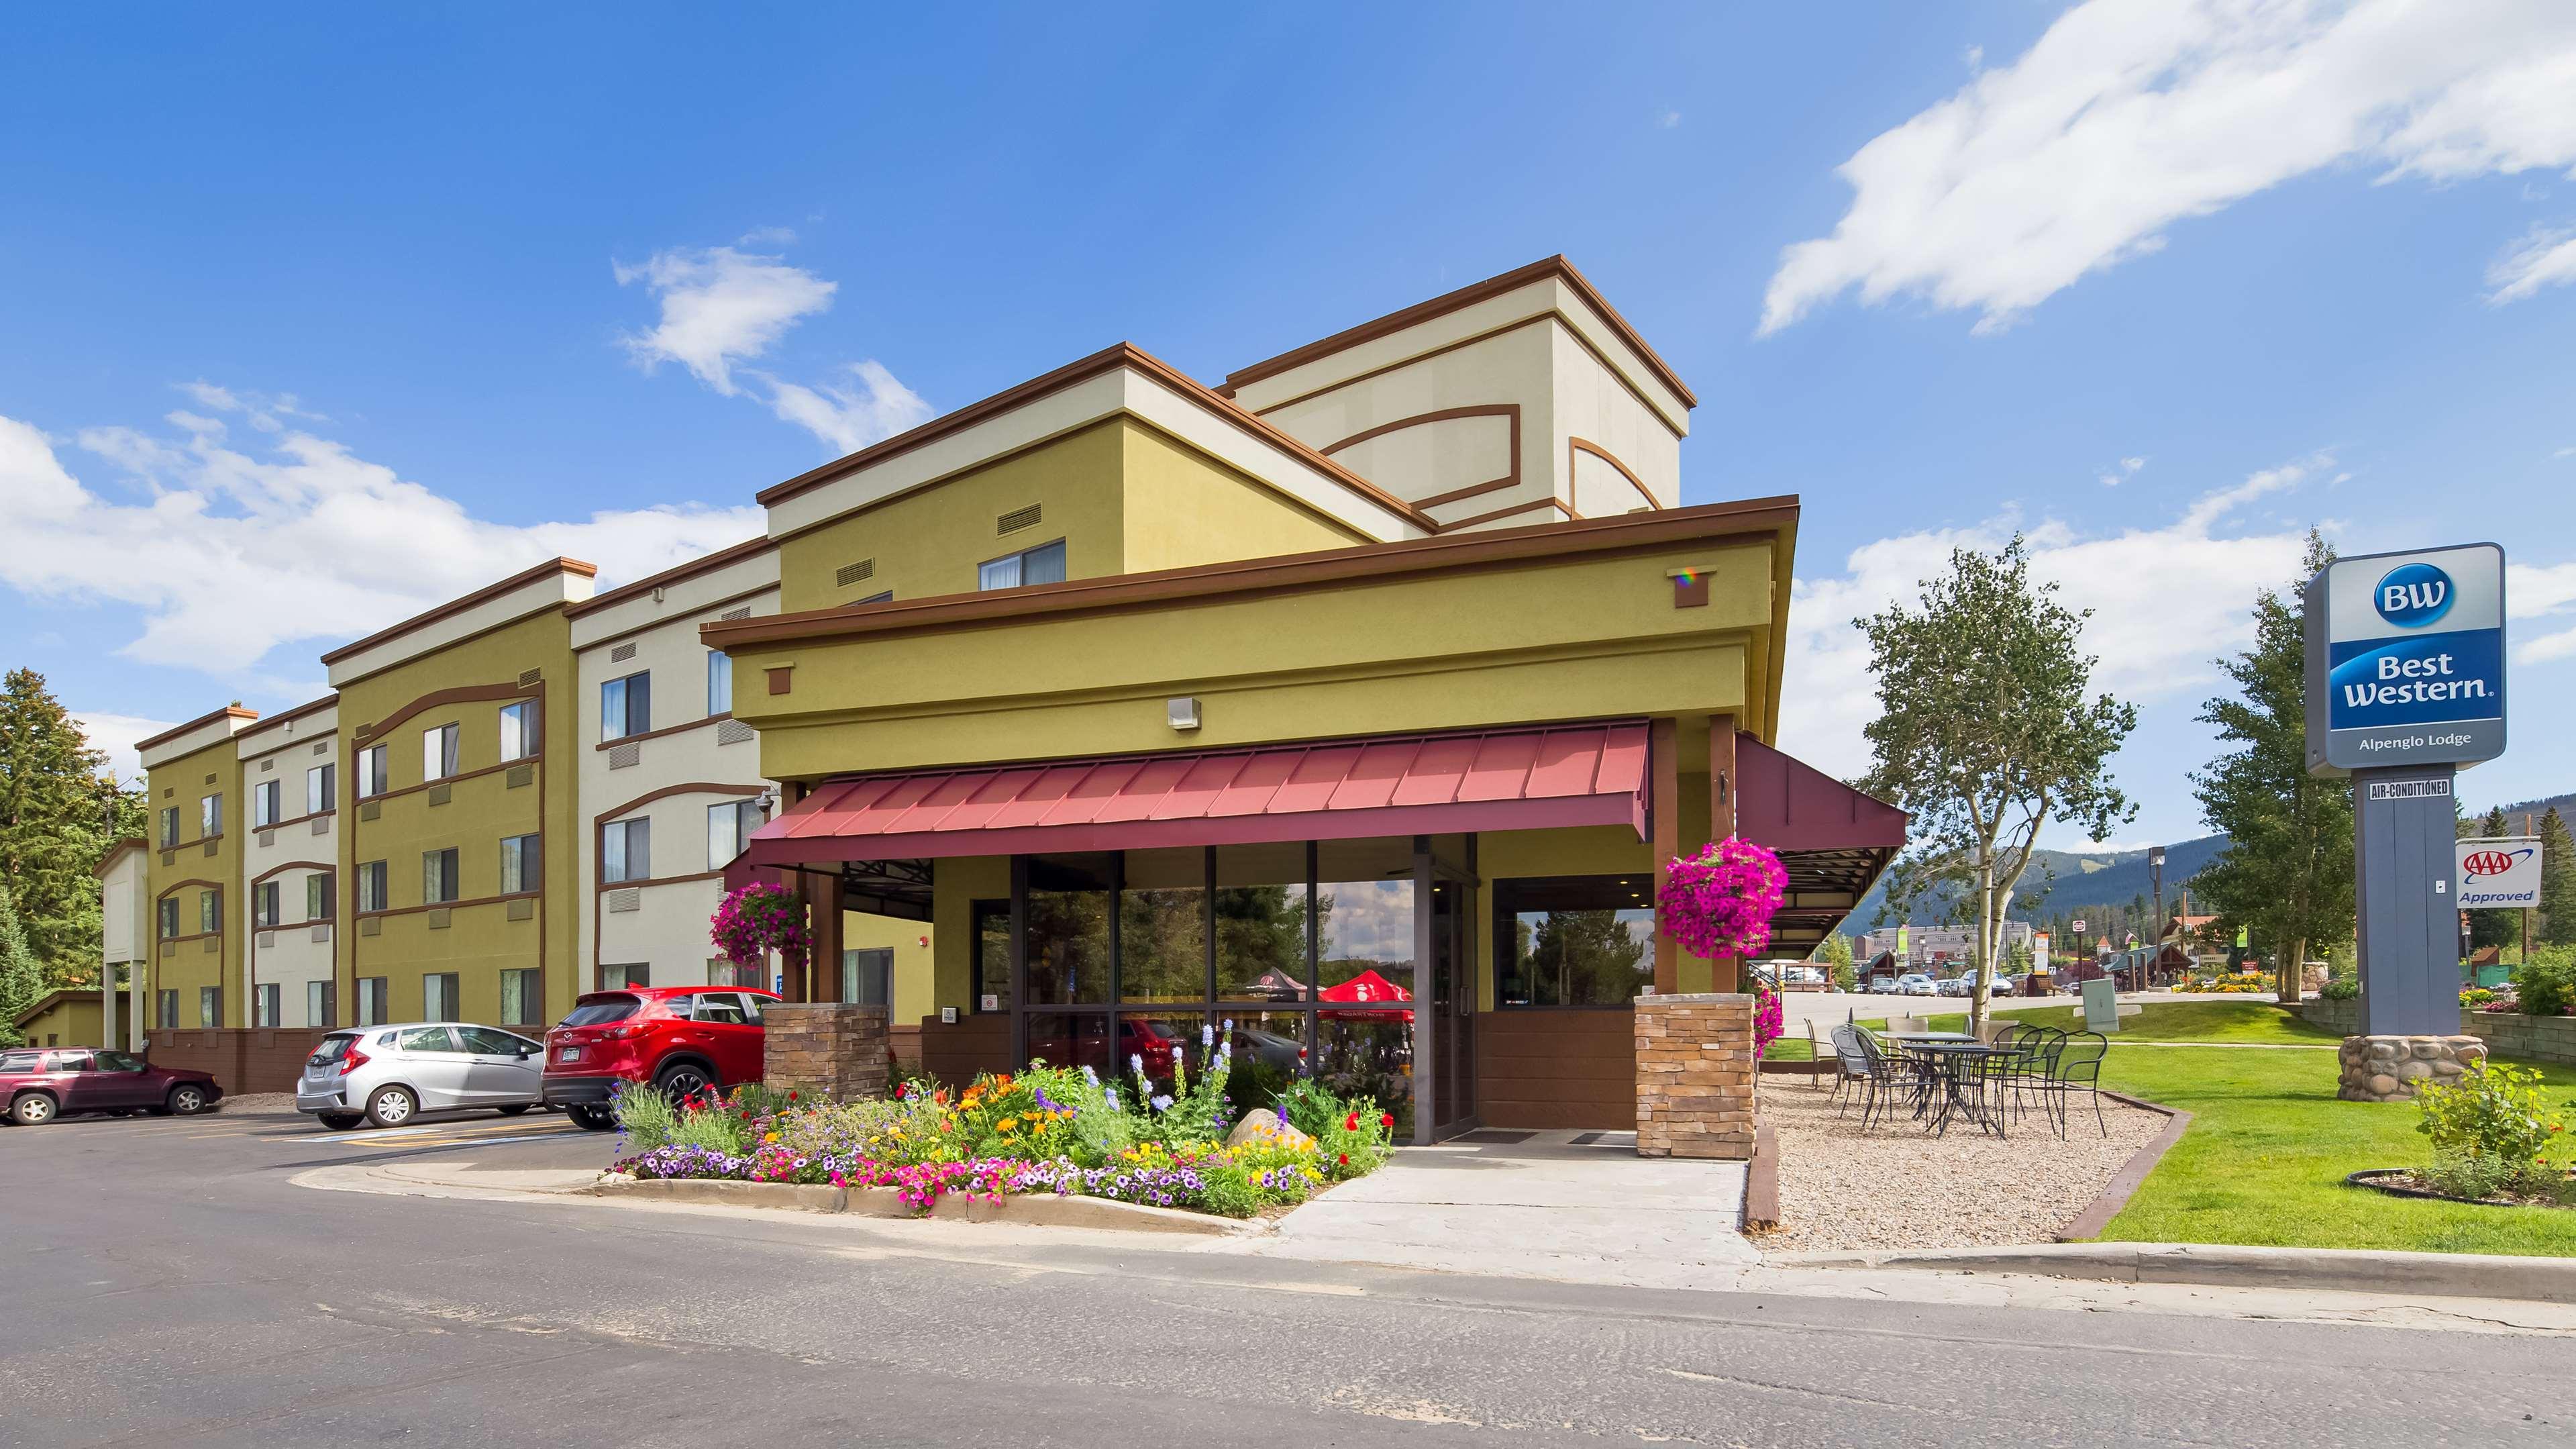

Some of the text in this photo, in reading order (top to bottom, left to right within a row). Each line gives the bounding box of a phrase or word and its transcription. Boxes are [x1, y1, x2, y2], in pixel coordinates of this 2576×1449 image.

[2384, 581, 2445, 611] BW
[2378, 654, 2453, 680] Best
[2359, 734, 2472, 751] Alpenglo Lodge
[2371, 781, 2448, 798] AIR-CONDITIONED
[2468, 852, 2509, 875] AAA
[2459, 890, 2534, 904] Approved
